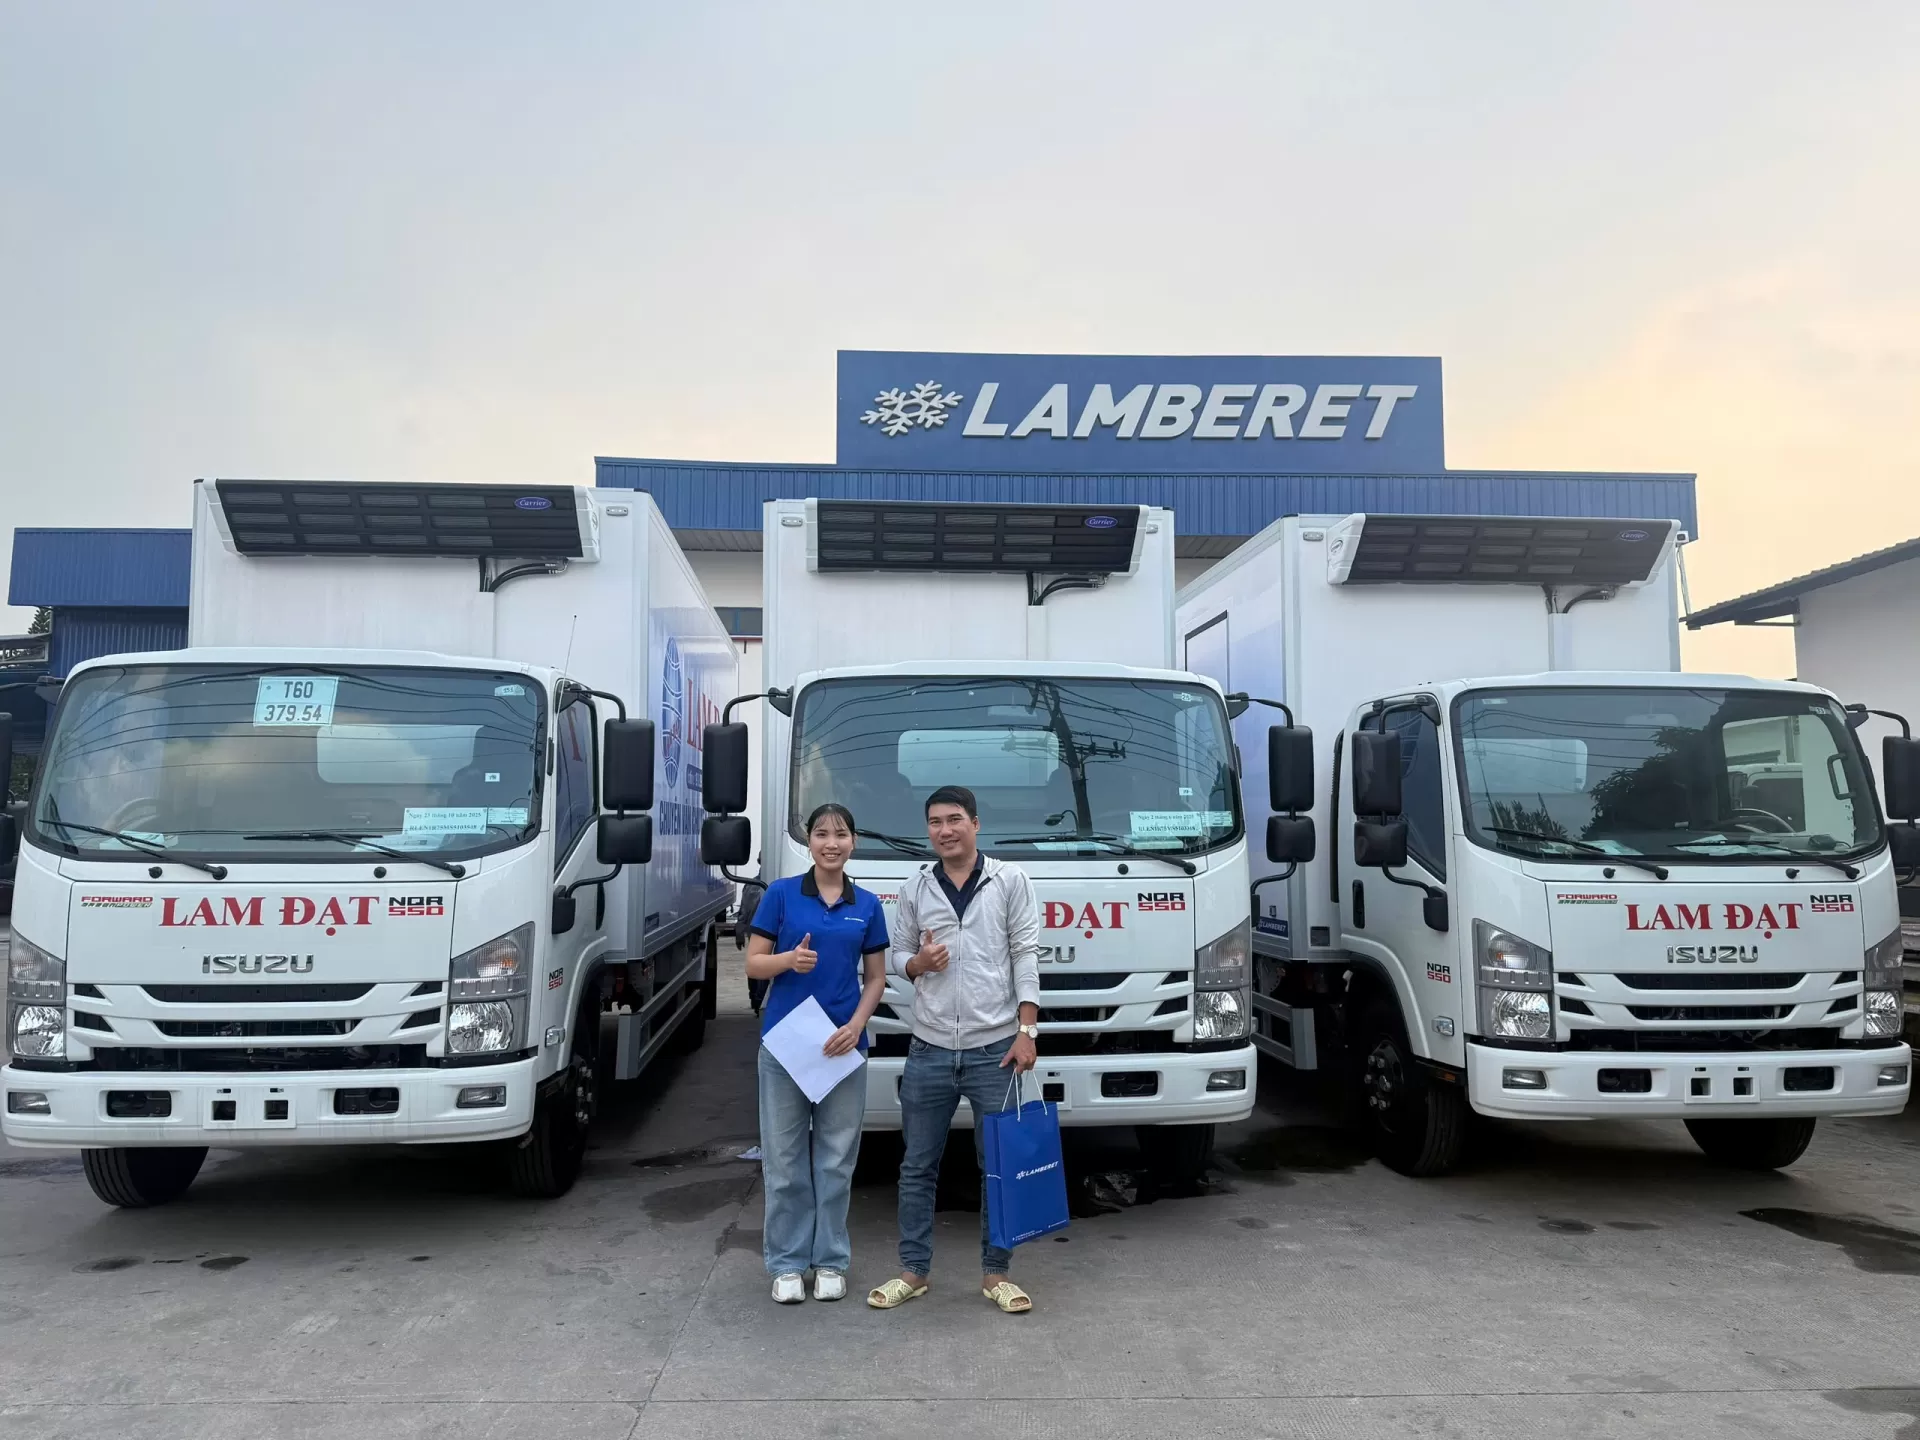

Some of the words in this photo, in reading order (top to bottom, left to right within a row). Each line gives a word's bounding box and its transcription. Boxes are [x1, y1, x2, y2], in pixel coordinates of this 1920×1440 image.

[962, 382, 1418, 440] LAMBERET
[284, 681, 314, 699] T60
[264, 704, 322, 722] 379.54
[388, 896, 444, 906] NQR
[1137, 892, 1185, 902] NQR
[1810, 894, 1853, 904] NQR
[388, 906, 444, 916] 550
[1138, 901, 1186, 911] 550
[1811, 903, 1855, 913] 550
[159, 896, 266, 927] LAM
[279, 896, 380, 937] ĐẠT
[1041, 901, 1130, 939] ĐẠT
[1624, 903, 1713, 930] LAM
[1723, 903, 1804, 940] ĐẠT
[1666, 945, 1759, 964] ISUZU
[202, 953, 314, 974] ISUZU
[1426, 961, 1450, 975] NQR
[548, 967, 564, 981] NQR
[1427, 970, 1452, 984] 550
[548, 976, 564, 990] 550
[1025, 1160, 1059, 1177] LAMBERET
